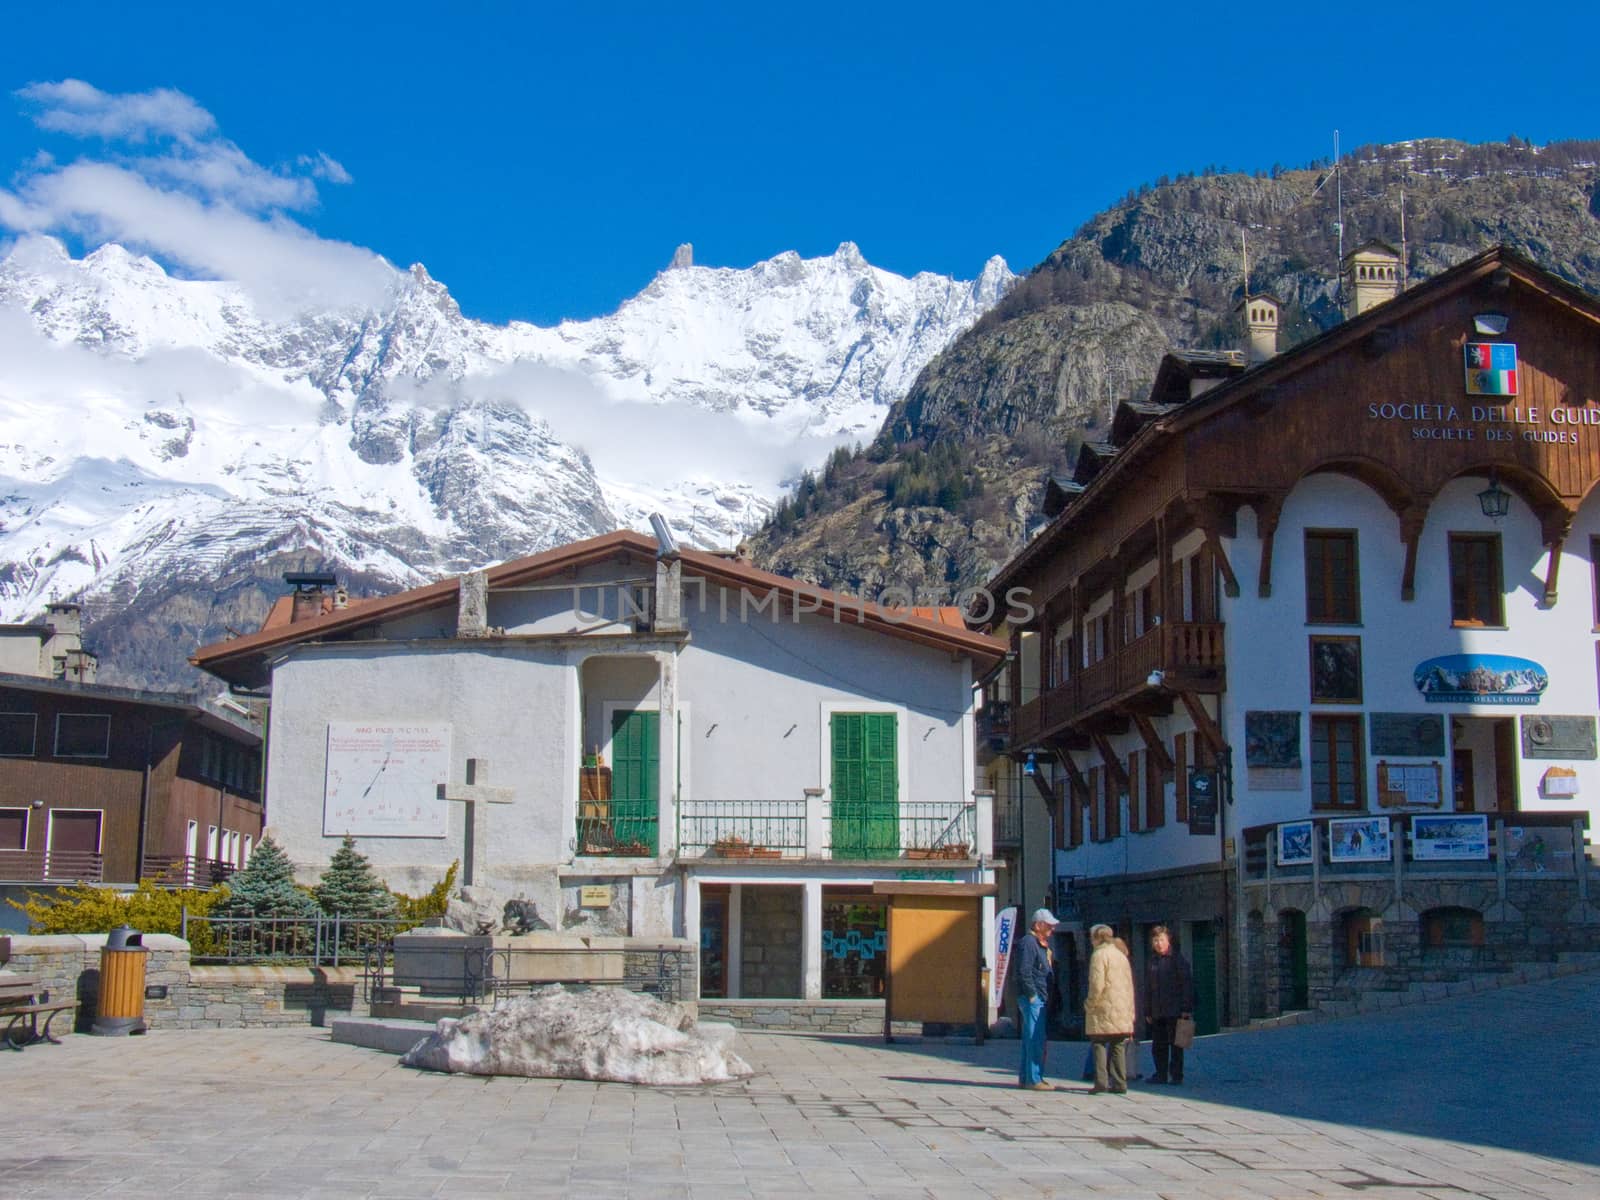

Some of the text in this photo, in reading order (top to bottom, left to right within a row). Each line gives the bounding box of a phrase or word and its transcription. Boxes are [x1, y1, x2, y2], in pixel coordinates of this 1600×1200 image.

[1472, 406, 1541, 424] DELLE
[1486, 430, 1514, 441] DES
[1523, 430, 1578, 444] GUIDES
[1506, 695, 1536, 703] GUIDE
